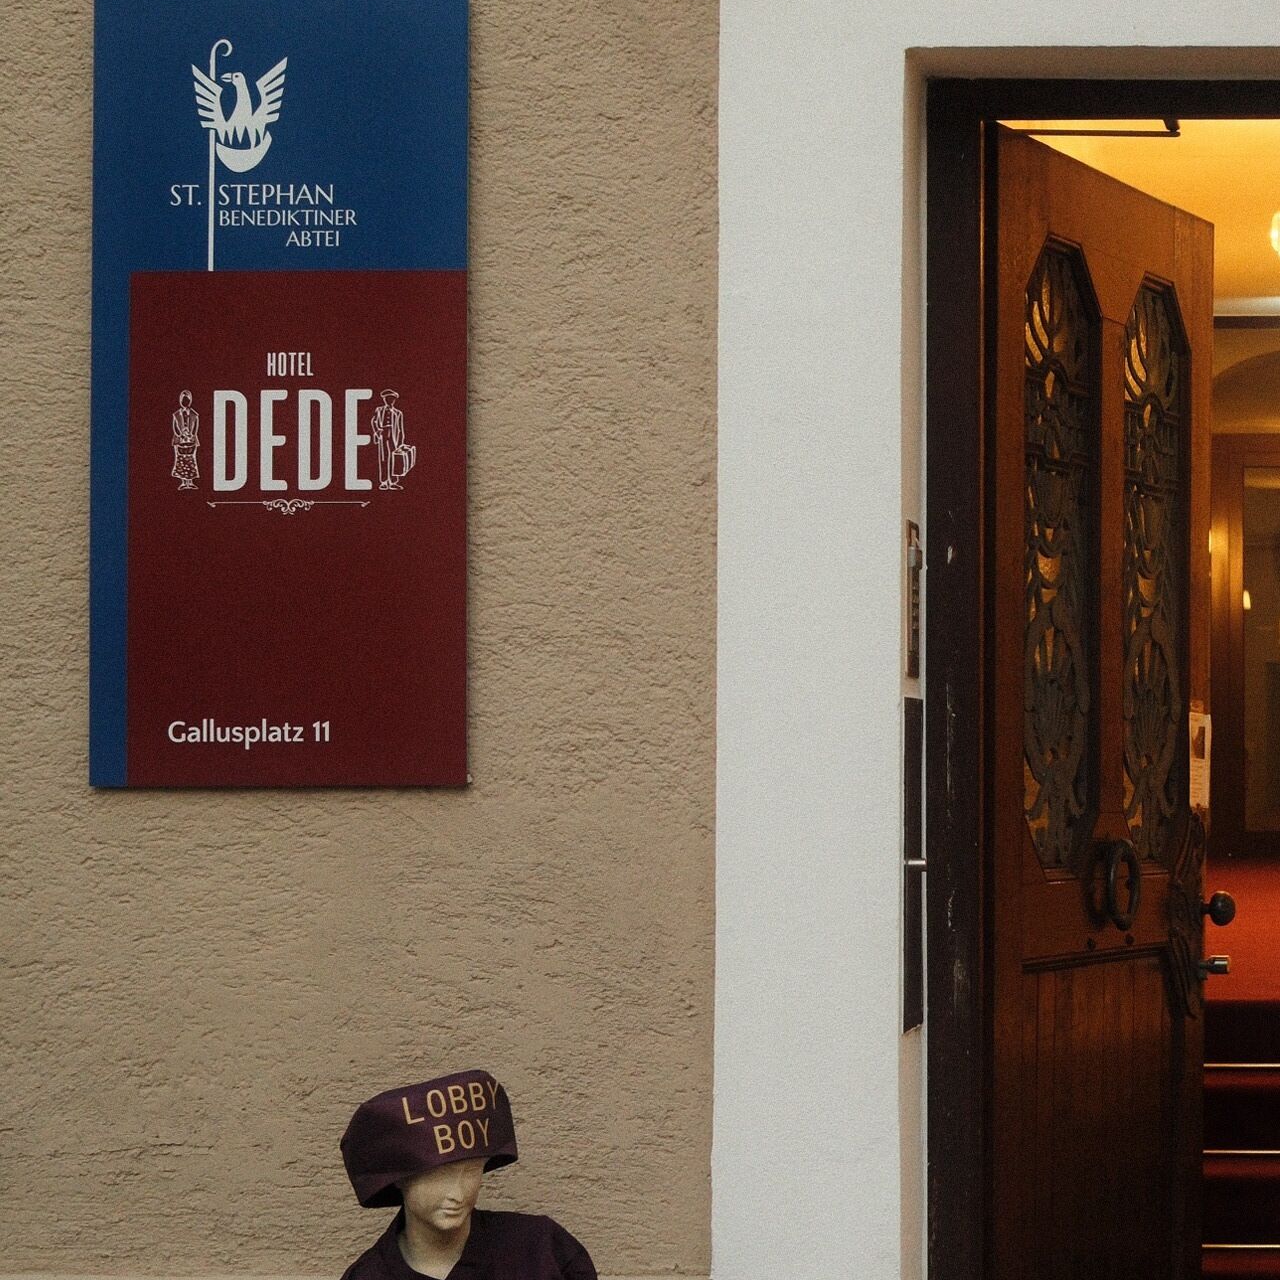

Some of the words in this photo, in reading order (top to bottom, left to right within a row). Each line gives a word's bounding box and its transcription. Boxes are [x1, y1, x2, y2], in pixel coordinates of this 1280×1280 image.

[169, 185, 202, 206] ST.
[218, 184, 334, 206] STEPHAN
[218, 209, 358, 227] BENEDIKTINER
[285, 230, 340, 247] ABTEI
[266, 352, 314, 377] HOTEL
[213, 389, 373, 492] DEDE
[167, 719, 304, 750] Gallusplatz
[312, 721, 331, 743] 11
[401, 1080, 500, 1125] LOBBY
[432, 1118, 491, 1155] BOY
